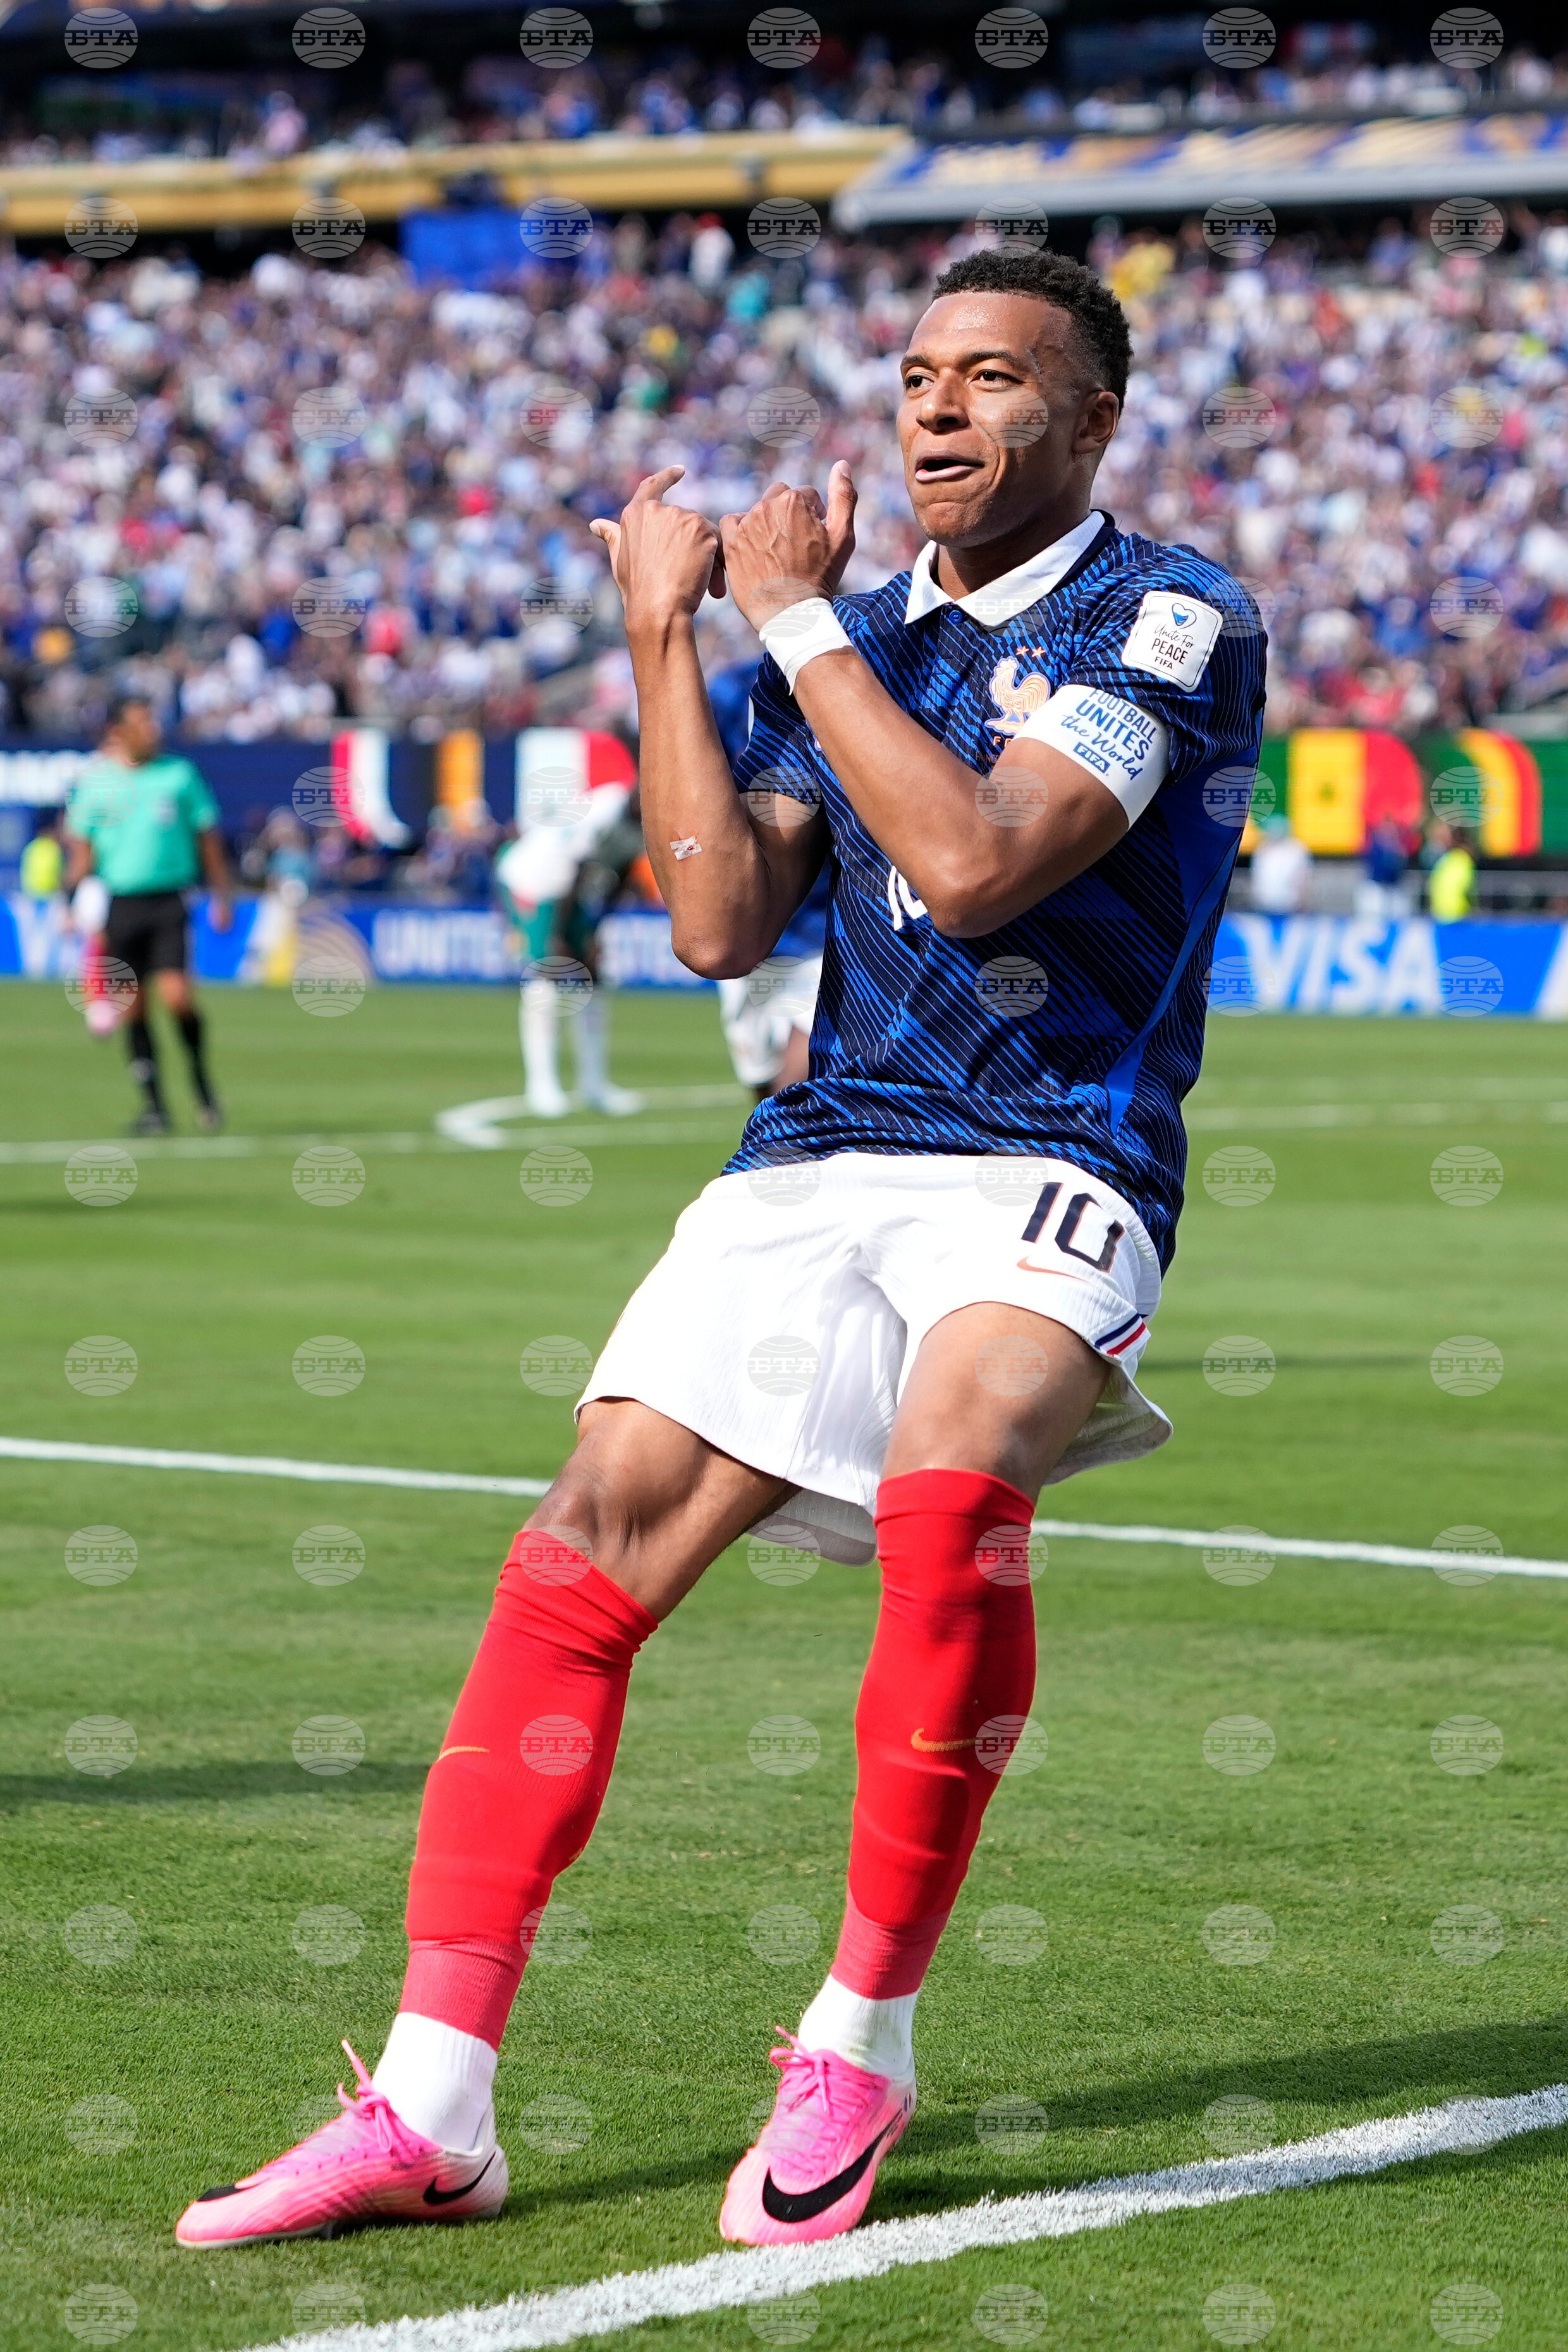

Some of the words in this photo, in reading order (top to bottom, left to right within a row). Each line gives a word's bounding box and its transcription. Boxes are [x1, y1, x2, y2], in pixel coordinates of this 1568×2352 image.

[1151, 638, 1188, 665] PEACE
[1155, 624, 1180, 641] Unite
[1181, 635, 1195, 648] For
[1155, 656, 1173, 670] FIFA
[1076, 699, 1149, 760] UNITES
[1089, 689, 1156, 744] FOOTBALL
[1061, 715, 1089, 737] the
[1091, 732, 1143, 780] World
[1076, 744, 1108, 772] FIFA
[1234, 916, 1445, 1013] VISA
[1021, 1181, 1125, 1273] 10
